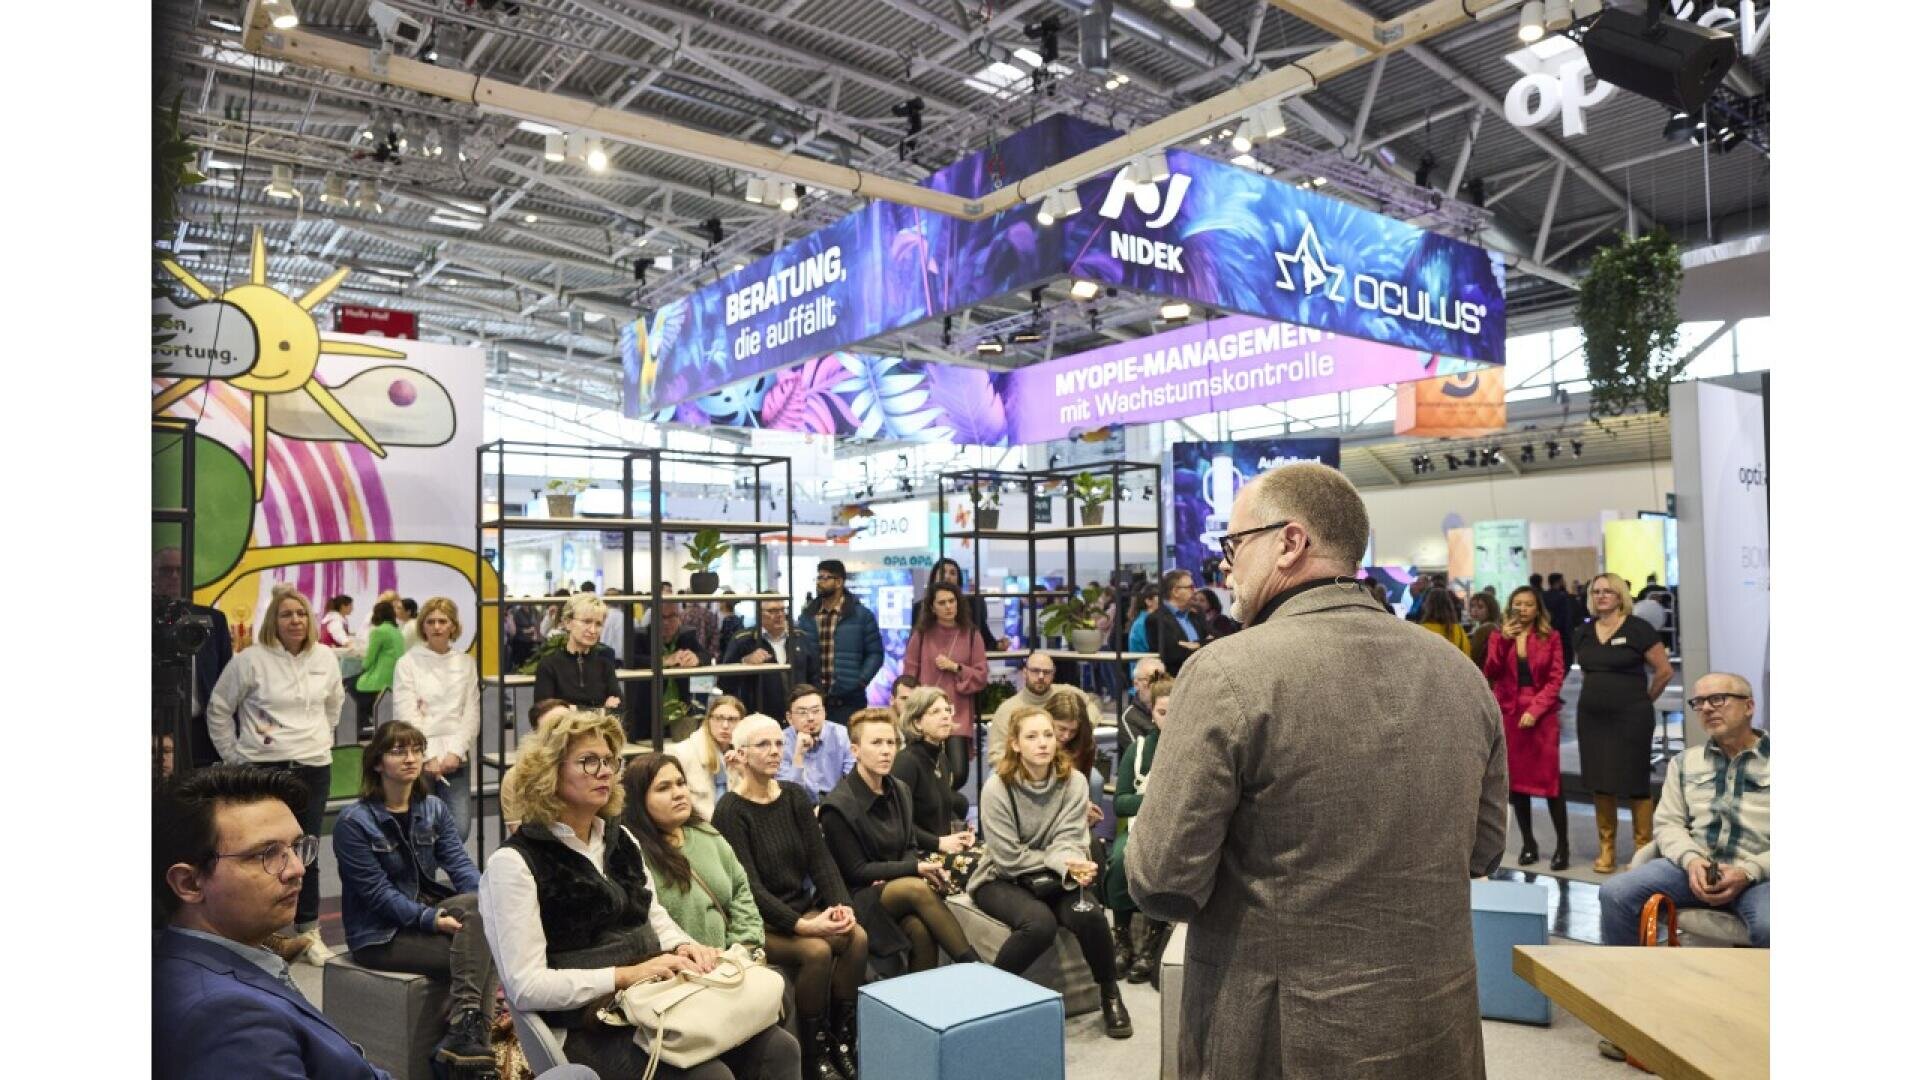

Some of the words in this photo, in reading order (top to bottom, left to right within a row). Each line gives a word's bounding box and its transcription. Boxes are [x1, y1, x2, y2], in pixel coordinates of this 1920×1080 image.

[726, 245, 847, 327] BERATUNG,
[1110, 230, 1185, 274] NIDEK
[735, 326, 761, 361] die
[766, 295, 837, 349] auffällt
[1060, 398, 1091, 424] mit
[1095, 350, 1335, 418] Wachstumskontrolle
